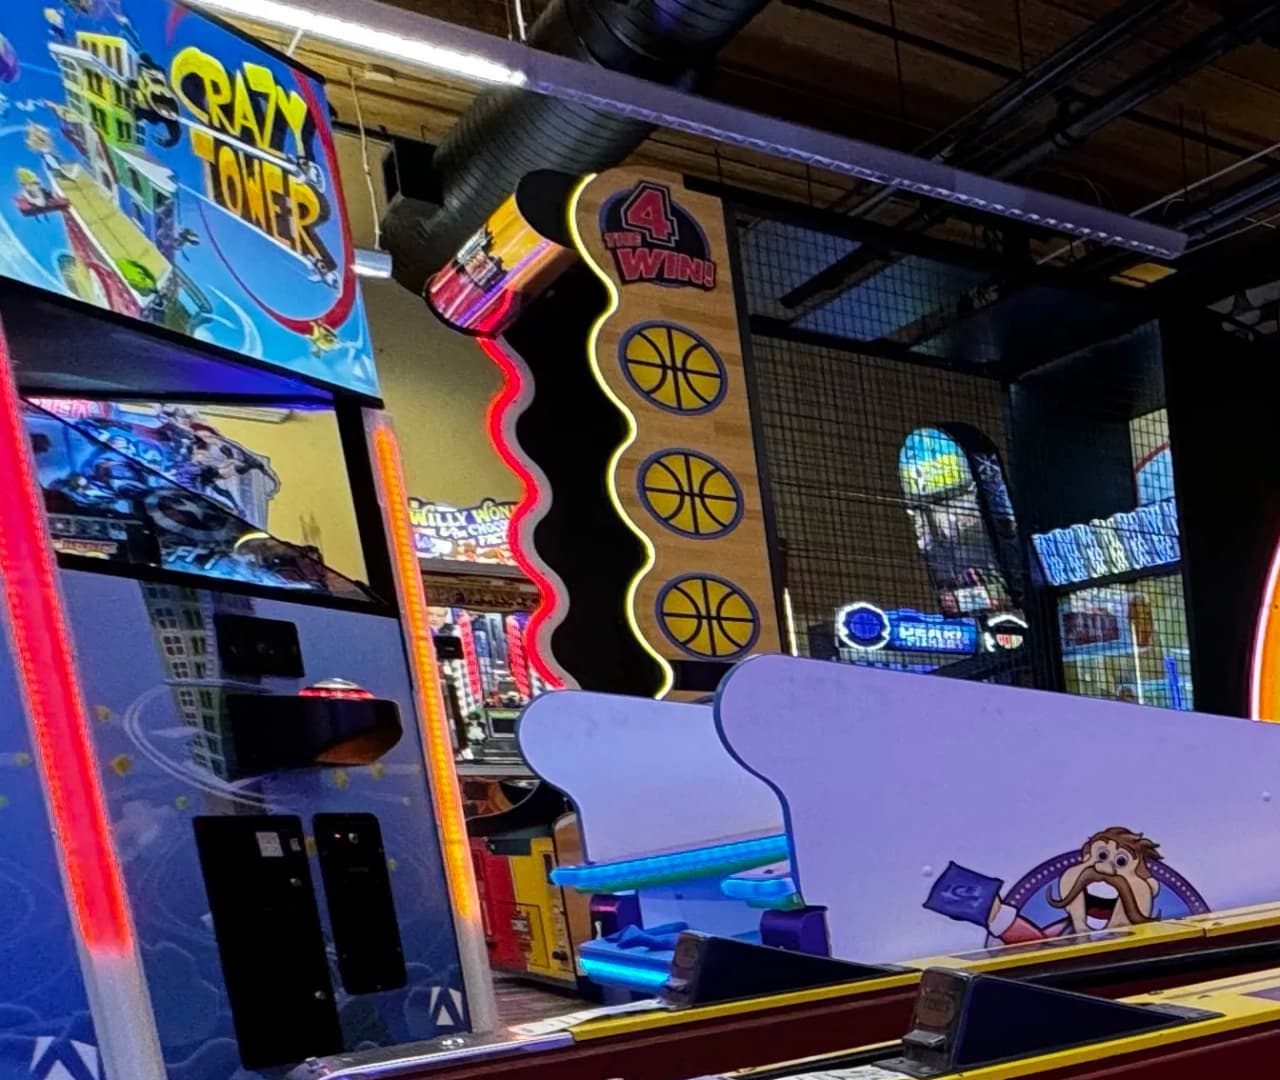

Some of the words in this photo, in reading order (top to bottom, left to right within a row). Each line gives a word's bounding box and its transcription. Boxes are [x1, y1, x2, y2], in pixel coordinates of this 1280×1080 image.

[171, 46, 308, 157] CRAZY
[190, 126, 327, 262] TOWER
[622, 182, 678, 247] 4
[615, 248, 717, 290] WIN!
